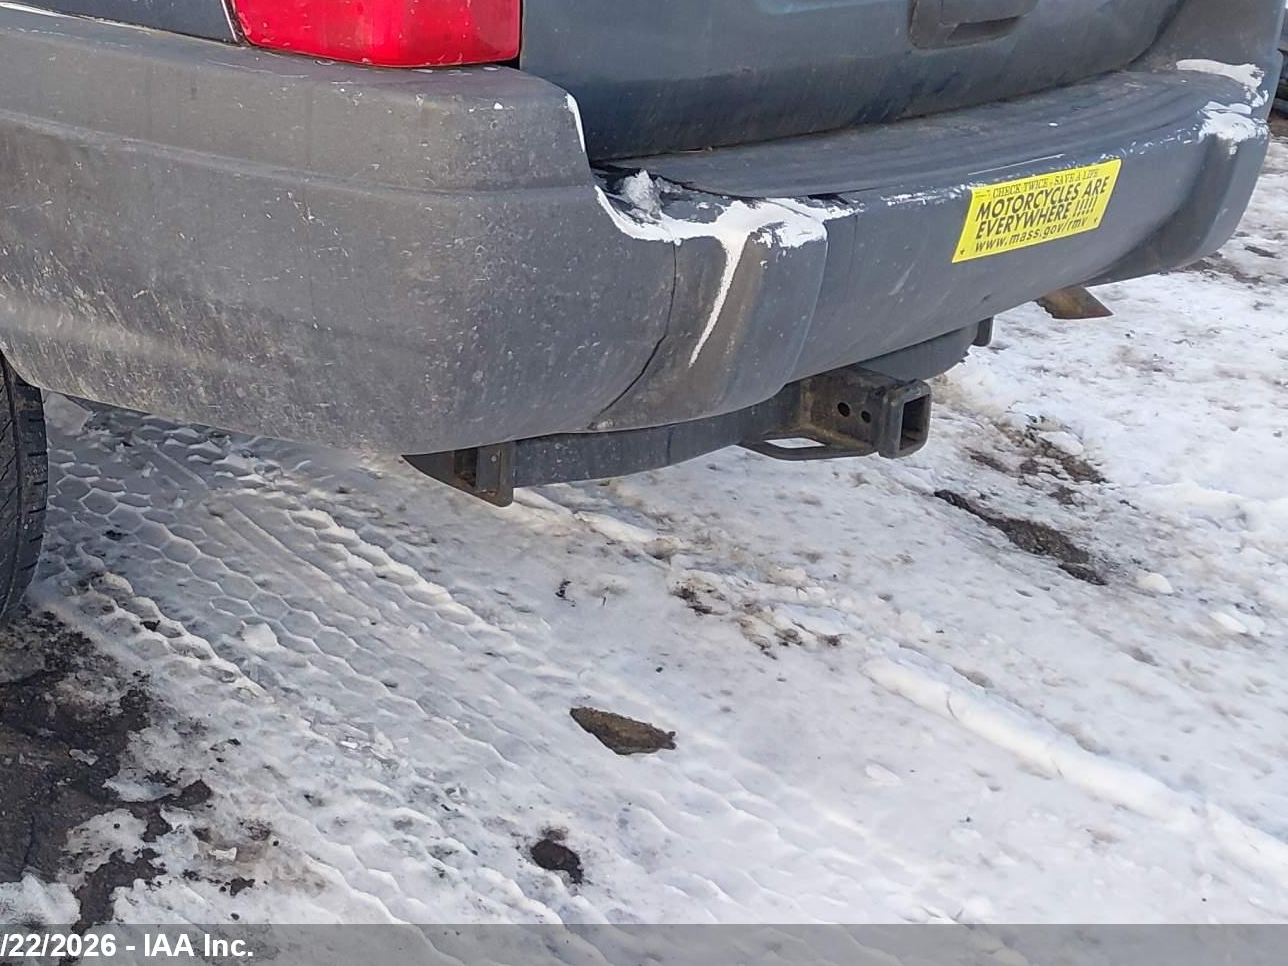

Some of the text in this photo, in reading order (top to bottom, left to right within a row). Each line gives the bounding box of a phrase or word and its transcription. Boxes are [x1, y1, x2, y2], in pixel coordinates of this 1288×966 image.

[976, 176, 1110, 222] MOTORCYCLES ARE
[993, 183, 1021, 199] CHECK
[1023, 177, 1049, 193] TWICE
[1054, 172, 1074, 186] SAVE
[1081, 168, 1099, 181] LIFE
[975, 217, 1088, 253] www.mass.gov/rmv
[976, 201, 1072, 240] EVERYWHERE
